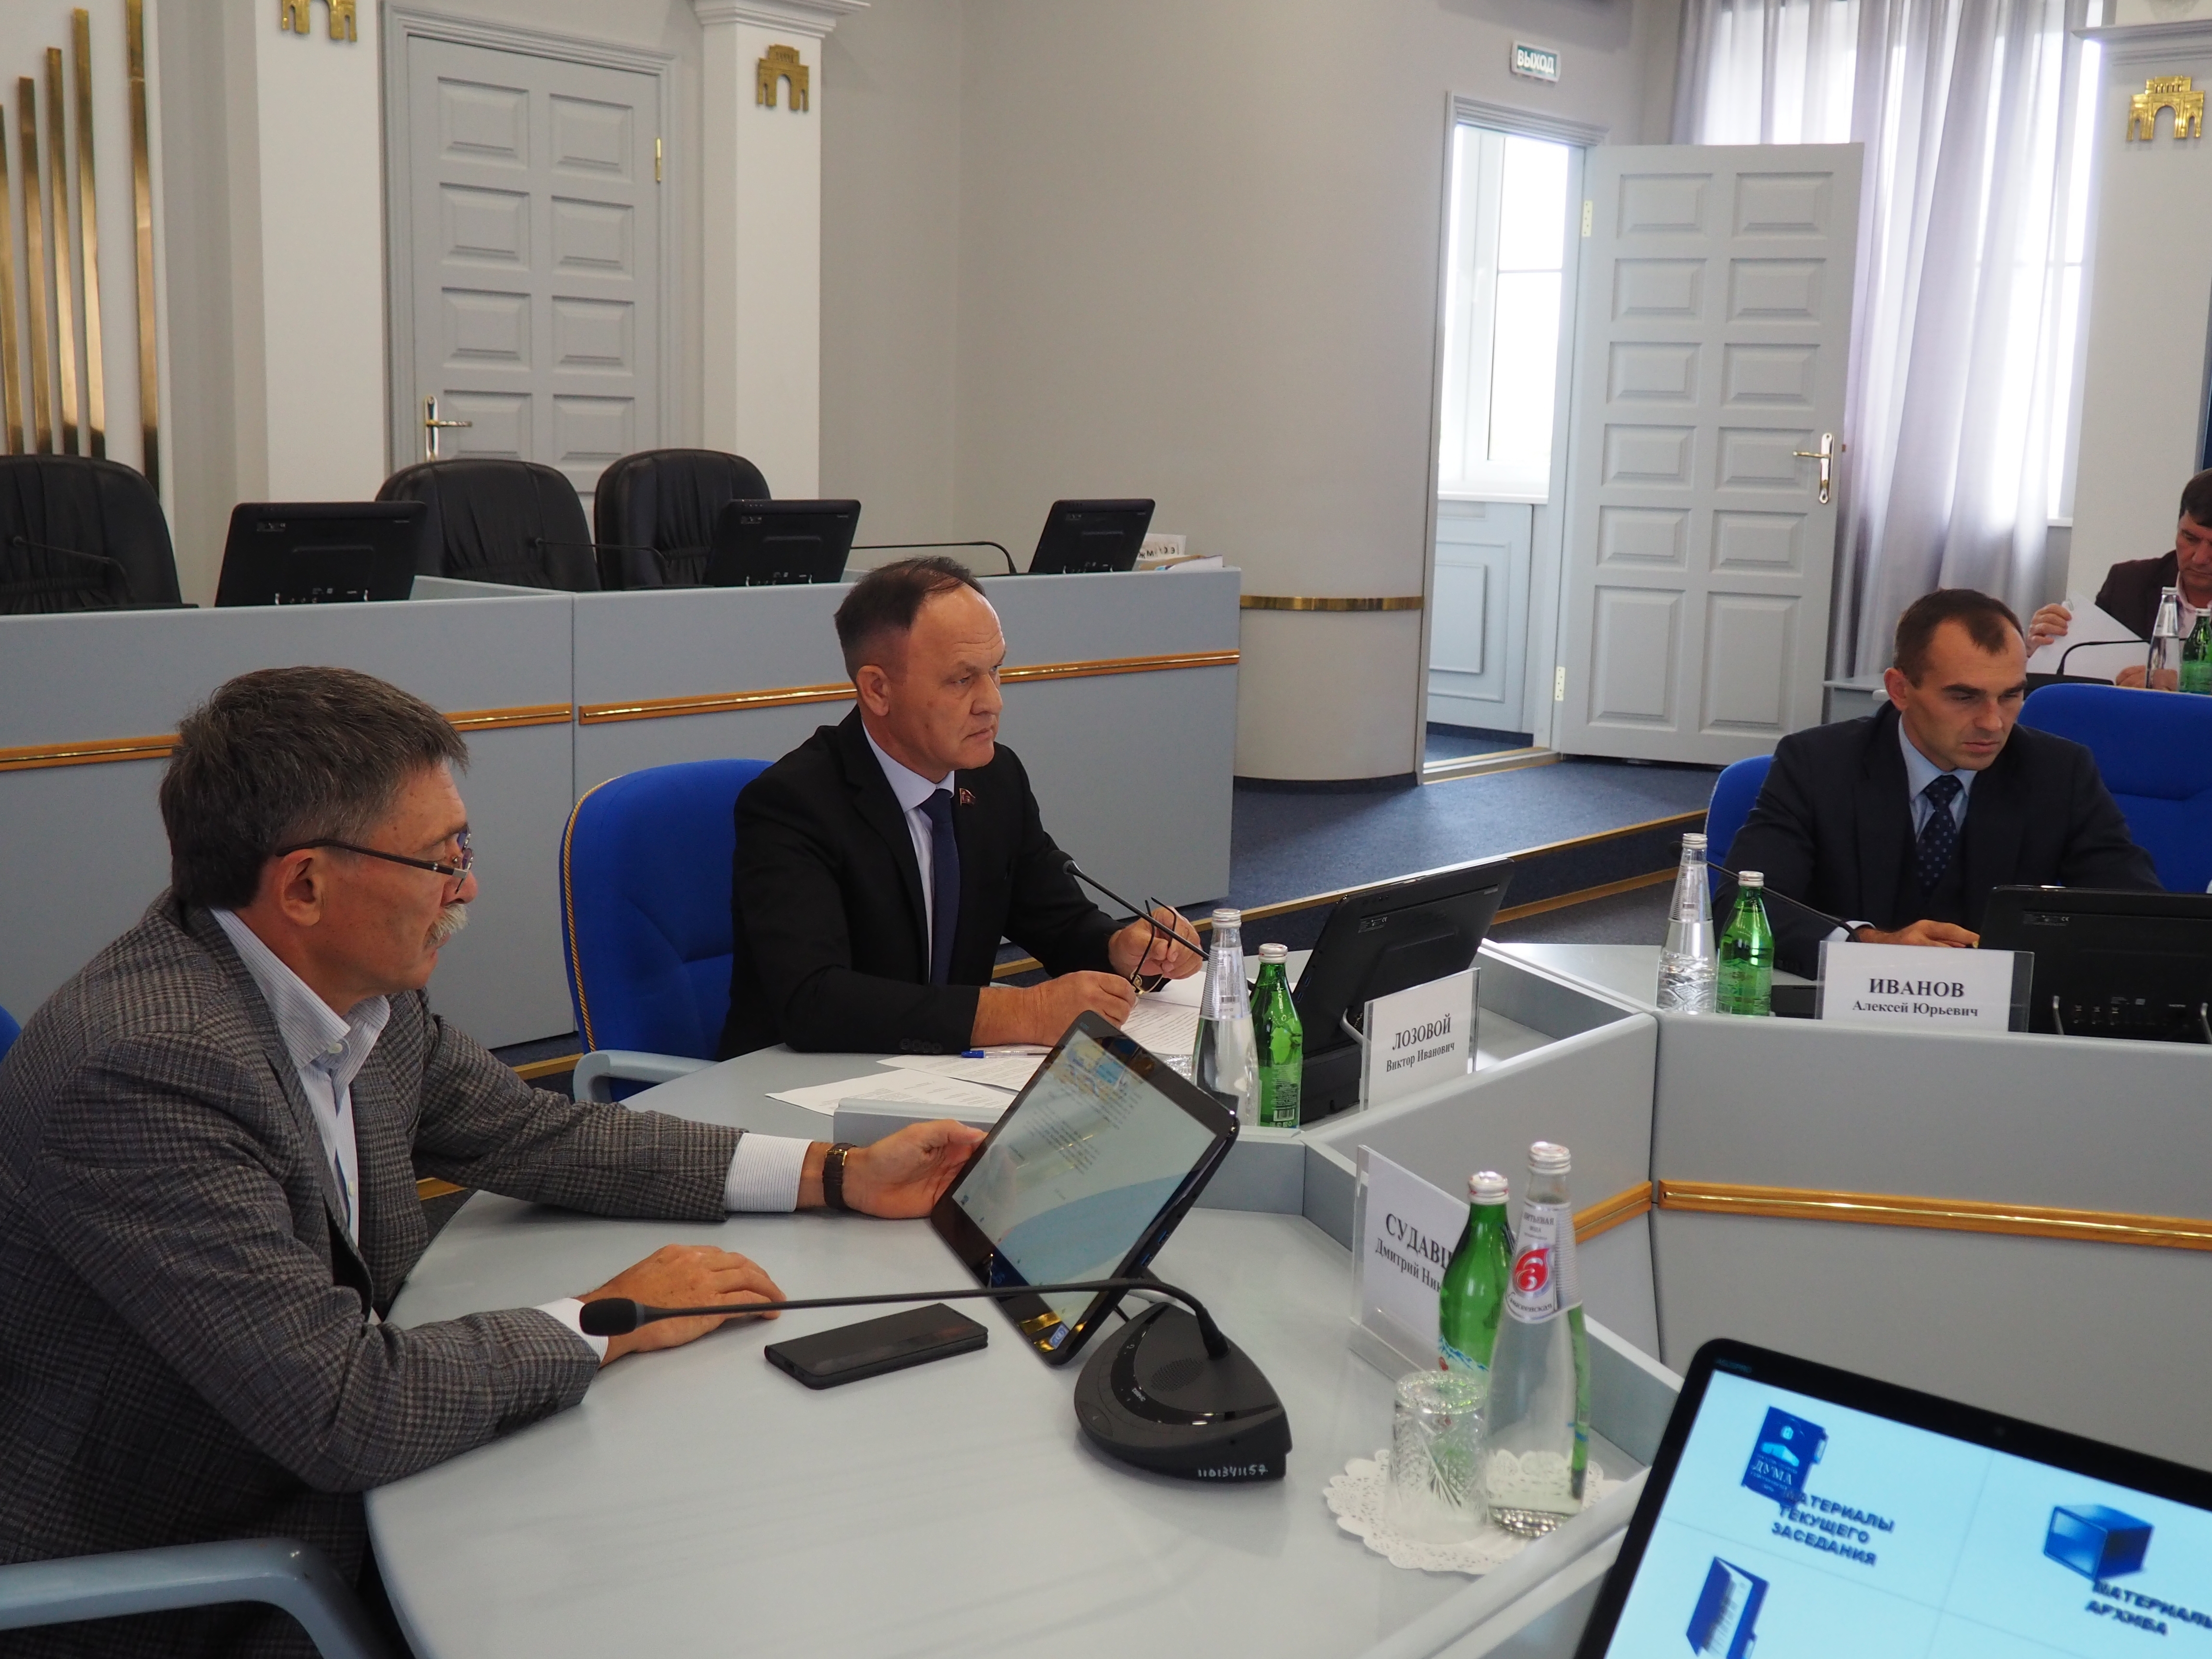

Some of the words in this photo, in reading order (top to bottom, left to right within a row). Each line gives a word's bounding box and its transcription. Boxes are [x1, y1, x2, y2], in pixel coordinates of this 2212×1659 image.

[1517, 49, 1554, 74] ВЫХОД
[1869, 978, 1964, 998] ИВАНОВ
[1852, 1000, 1909, 1013] Алексей
[1913, 1002, 1979, 1017] Юрьевич
[1392, 1013, 1451, 1050] ЛОЗОВОЙ
[1386, 1055, 1415, 1072] Виктор
[1417, 1042, 1455, 1062] Иванович
[1375, 1238, 1419, 1279] Дмитрий
[1752, 1460, 1792, 1485] ДУМА
[1779, 1503, 1871, 1544] ТЕКУЩЕГО
[1771, 1521, 1879, 1567] ЗАСЕДАНИЯ
[2084, 1600, 2169, 1636] АРХИВА
